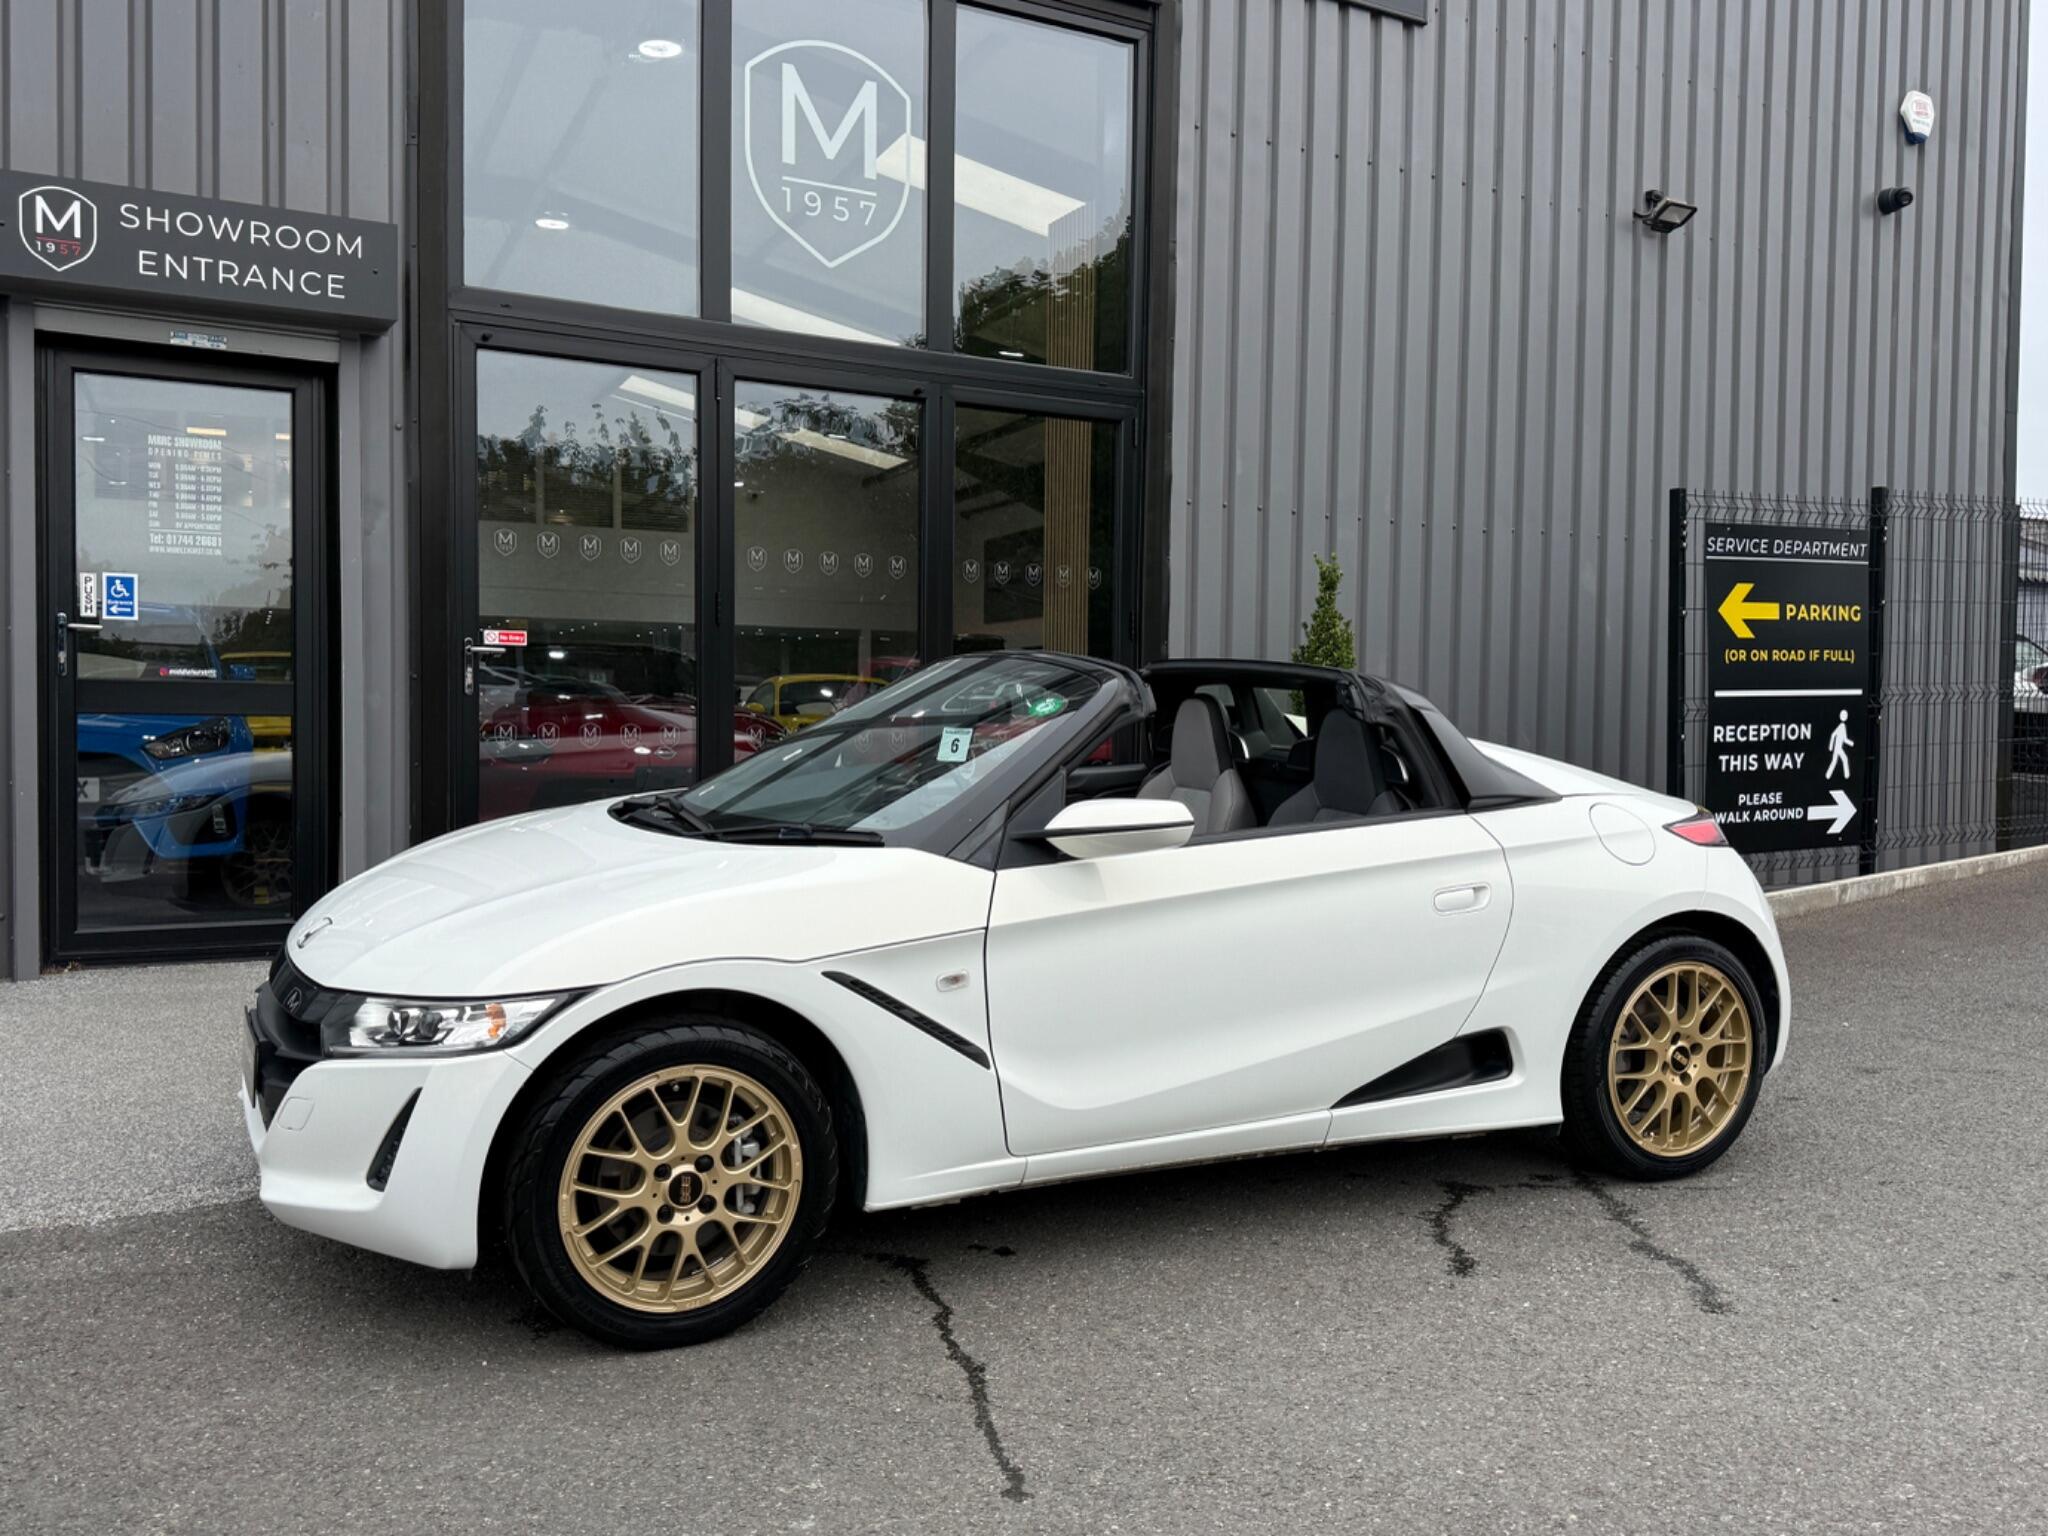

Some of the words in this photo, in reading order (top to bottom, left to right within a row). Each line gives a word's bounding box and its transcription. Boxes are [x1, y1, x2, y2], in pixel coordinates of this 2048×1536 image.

[781, 62, 877, 180] M
[781, 186, 877, 226] 1957
[35, 195, 81, 239] M
[119, 203, 362, 259] SHOWROOM
[36, 240, 81, 257] 1957
[138, 250, 346, 299] ENTRANCE
[1707, 536, 1769, 554] SERVICE
[1773, 539, 1867, 557] DEPARTMENT
[84, 576, 93, 614] PUSH
[1785, 603, 1862, 623] PARKING
[1725, 649, 1747, 664] (OR
[1750, 650, 1768, 663] ON
[1772, 649, 1805, 663] ROAD
[1809, 650, 1820, 663] IF
[1823, 649, 1855, 664] FULL)
[1713, 723, 1812, 743] RECEPTION
[951, 737, 960, 754] 6
[1719, 753, 1759, 772] THIS
[1764, 752, 1805, 770] WAY
[1738, 792, 1783, 806] PLEASE
[1715, 809, 1750, 824] WALK
[1753, 807, 1804, 822] AROUND
